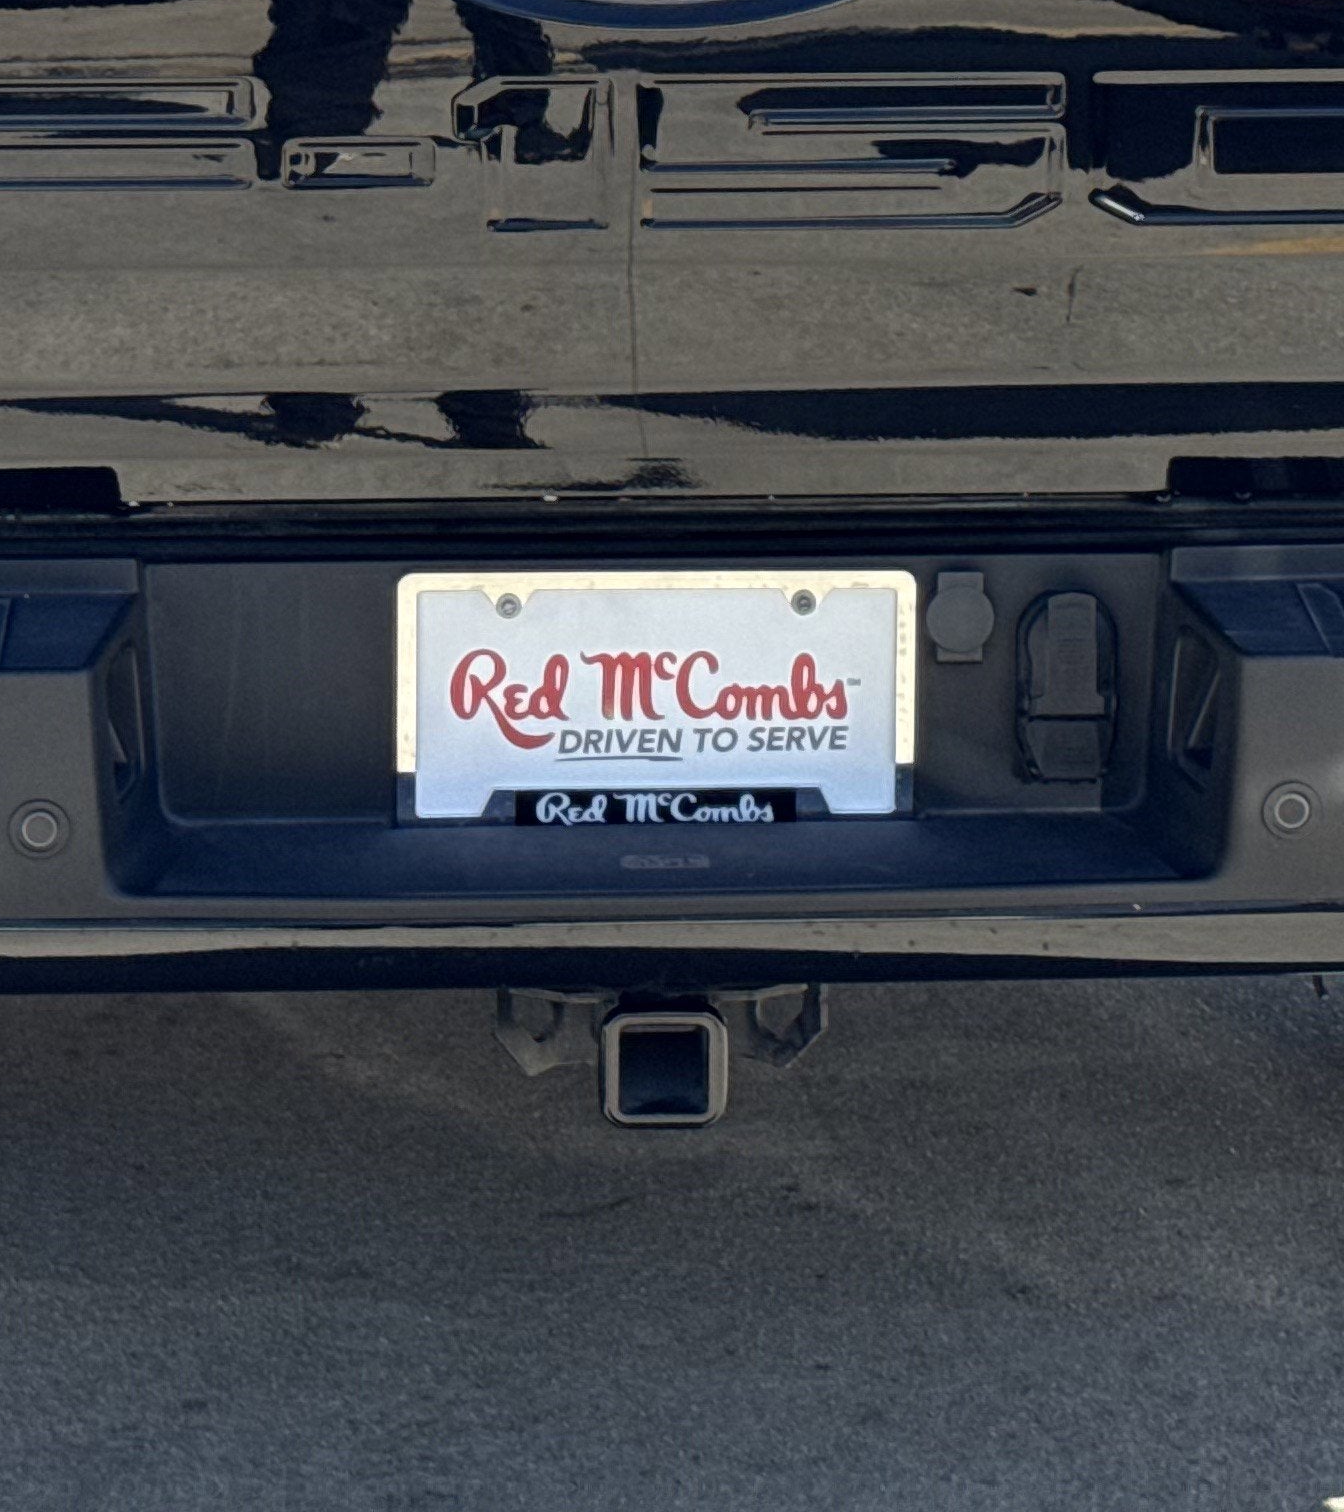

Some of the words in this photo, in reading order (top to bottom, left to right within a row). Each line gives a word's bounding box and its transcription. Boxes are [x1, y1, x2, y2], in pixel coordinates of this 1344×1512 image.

[450, 648, 570, 749] Red
[579, 650, 849, 721] McCombs
[558, 728, 683, 754] DRIVEN
[693, 727, 739, 753] TO
[746, 725, 850, 752] SERVE
[536, 793, 608, 826] Red
[612, 793, 774, 823] McCombs
